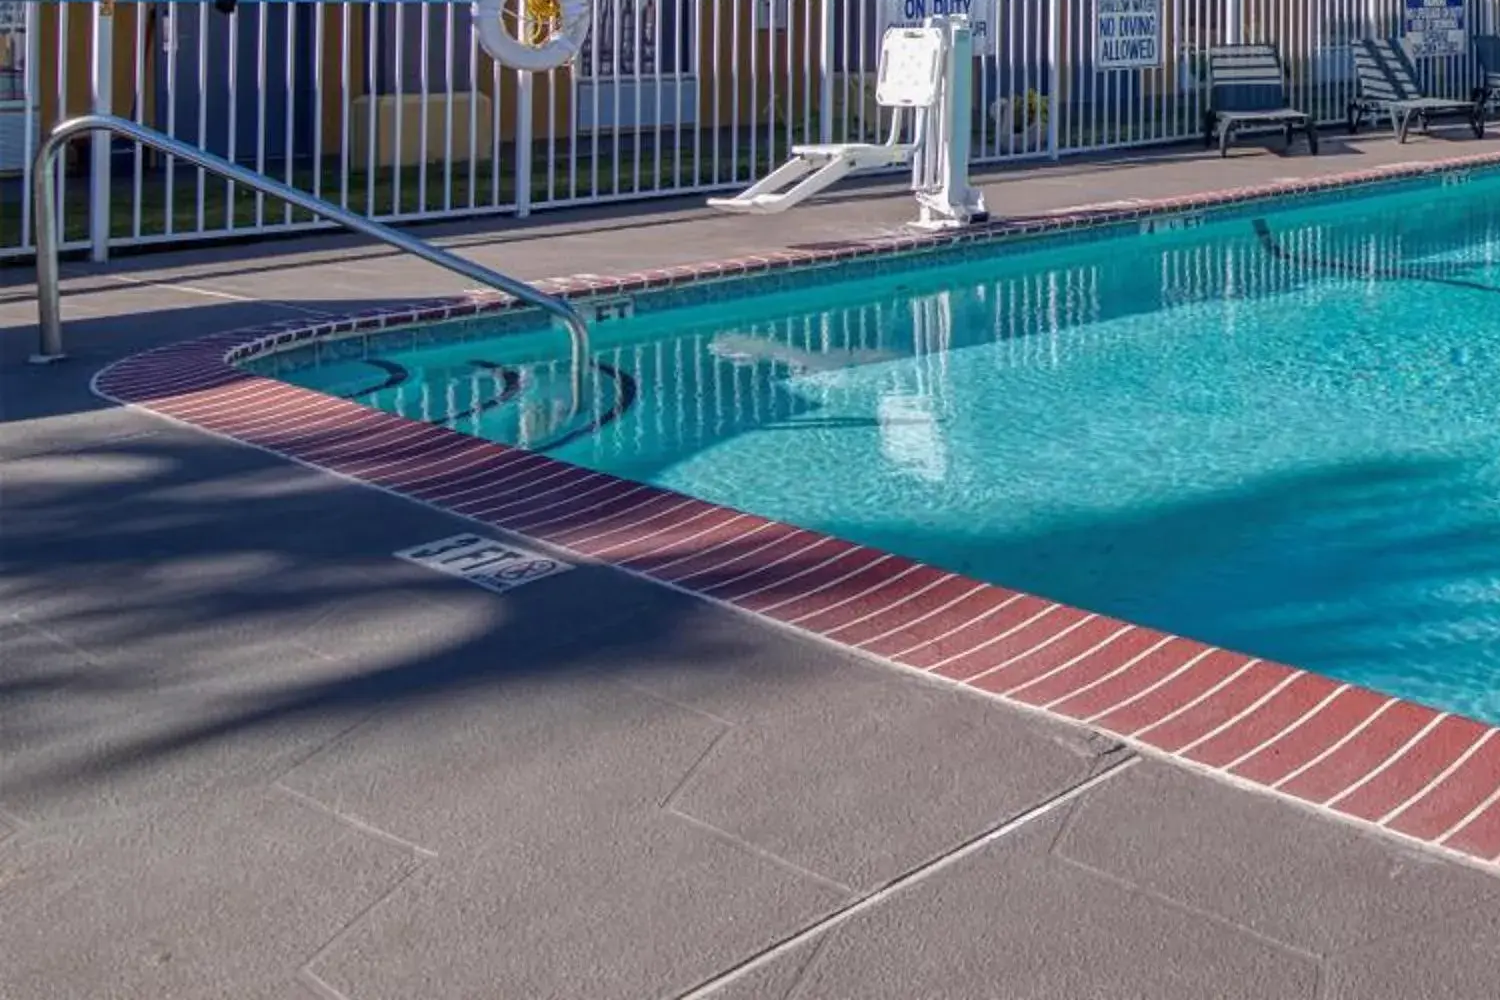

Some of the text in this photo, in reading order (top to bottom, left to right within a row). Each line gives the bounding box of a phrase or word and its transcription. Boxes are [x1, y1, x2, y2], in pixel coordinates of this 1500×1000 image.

[1100, 16, 1155, 37] NO DIVING
[1101, 39, 1155, 61] ALLOWED
[595, 301, 631, 322] FT
[441, 546, 524, 572] FT
